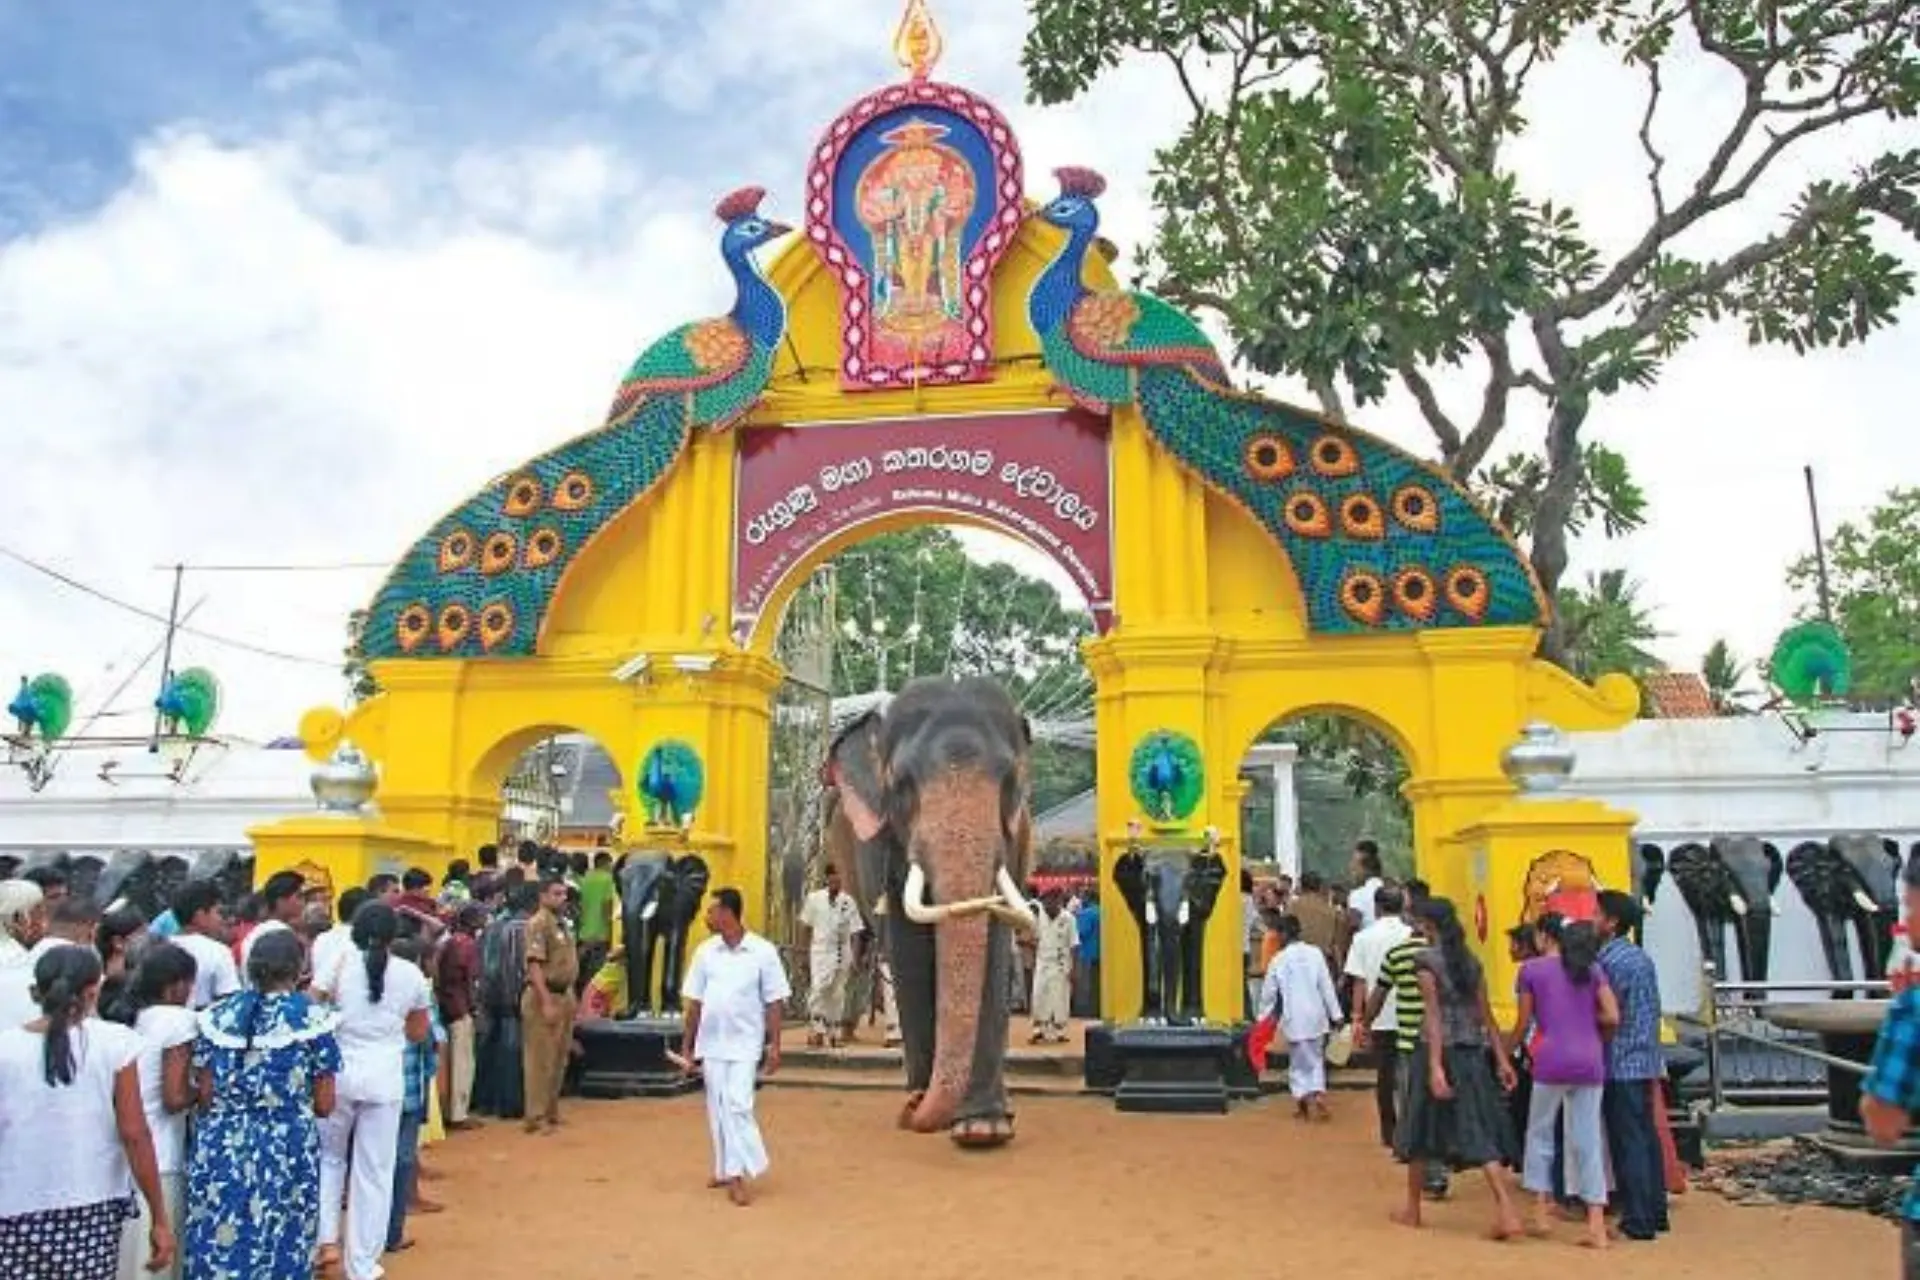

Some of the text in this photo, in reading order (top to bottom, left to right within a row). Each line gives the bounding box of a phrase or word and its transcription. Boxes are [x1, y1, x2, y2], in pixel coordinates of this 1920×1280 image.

[819, 456, 872, 492] මහා
[883, 445, 994, 476] කතරගම
[1000, 461, 1099, 531] දේවාලය
